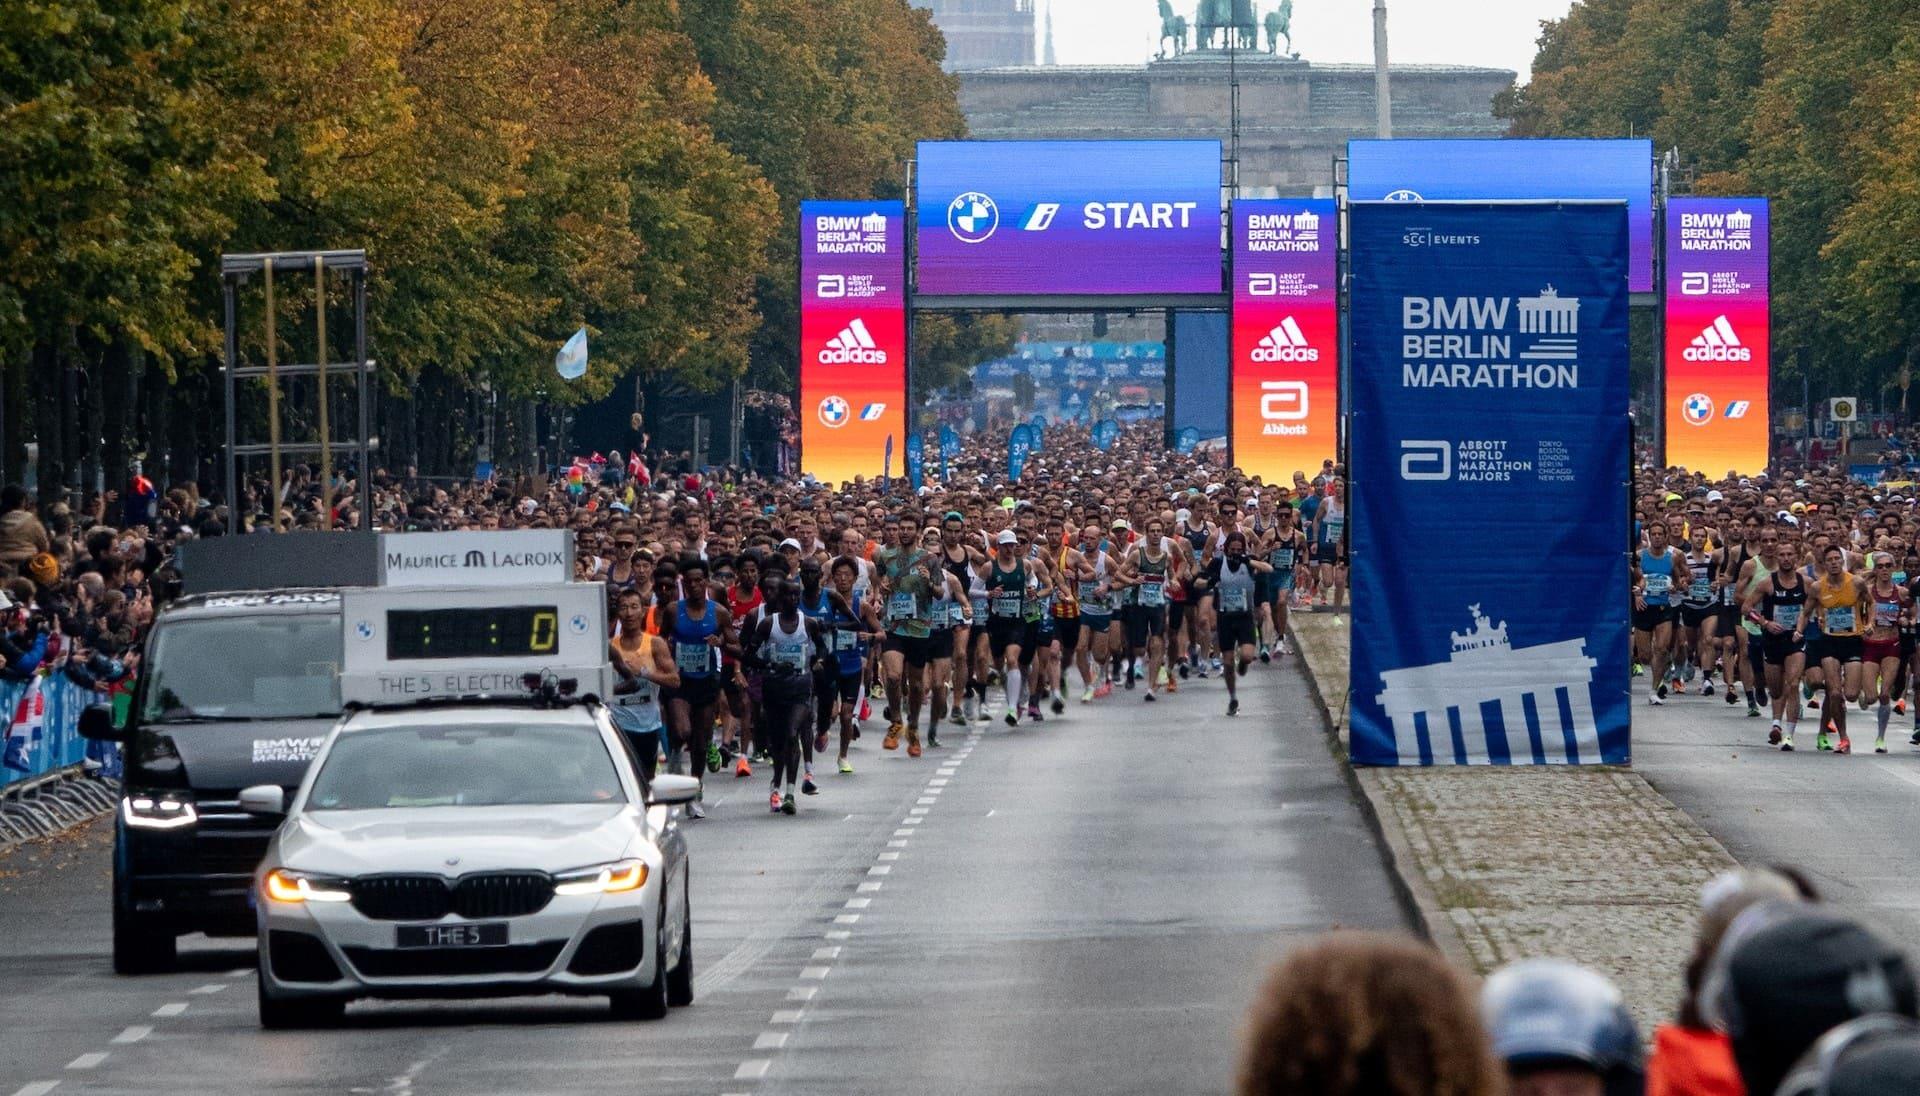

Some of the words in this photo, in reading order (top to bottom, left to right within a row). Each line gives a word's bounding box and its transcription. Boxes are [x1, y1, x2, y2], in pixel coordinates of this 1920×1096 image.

[1083, 201, 1197, 229] START
[1248, 214, 1291, 229] BMW
[1681, 213, 1725, 228] BMW
[816, 216, 860, 231] BMW
[817, 231, 861, 242] BERLIN
[1248, 230, 1292, 240] BERLIN
[1403, 234, 1425, 246] SCC
[1434, 235, 1480, 245] EVENTS
[1681, 228, 1725, 239] BERLIN
[817, 242, 886, 253] MARATHON
[1248, 240, 1319, 251] MARATHON
[1681, 239, 1751, 250] MARATHON
[1403, 297, 1510, 330] BMW
[1250, 345, 1319, 362] adidas
[1403, 335, 1510, 359] BERLIN
[1682, 345, 1751, 361] adidas
[818, 346, 887, 364] adidas
[1402, 363, 1578, 389] MARATHON
[1262, 423, 1308, 435] Abbott
[1458, 440, 1507, 450] ABBOTT
[1458, 450, 1503, 460] WORLD
[1458, 461, 1532, 471] MARATHON
[1458, 471, 1511, 481] MAJORS
[387, 553, 458, 569] MAURICE
[493, 551, 564, 568] LACROIX
[378, 677, 416, 693] THE
[421, 678, 432, 692] 5
[445, 674, 523, 692] ELECTR
[253, 738, 309, 749] BMW
[425, 927, 465, 945] THE
[468, 926, 480, 944] 5
